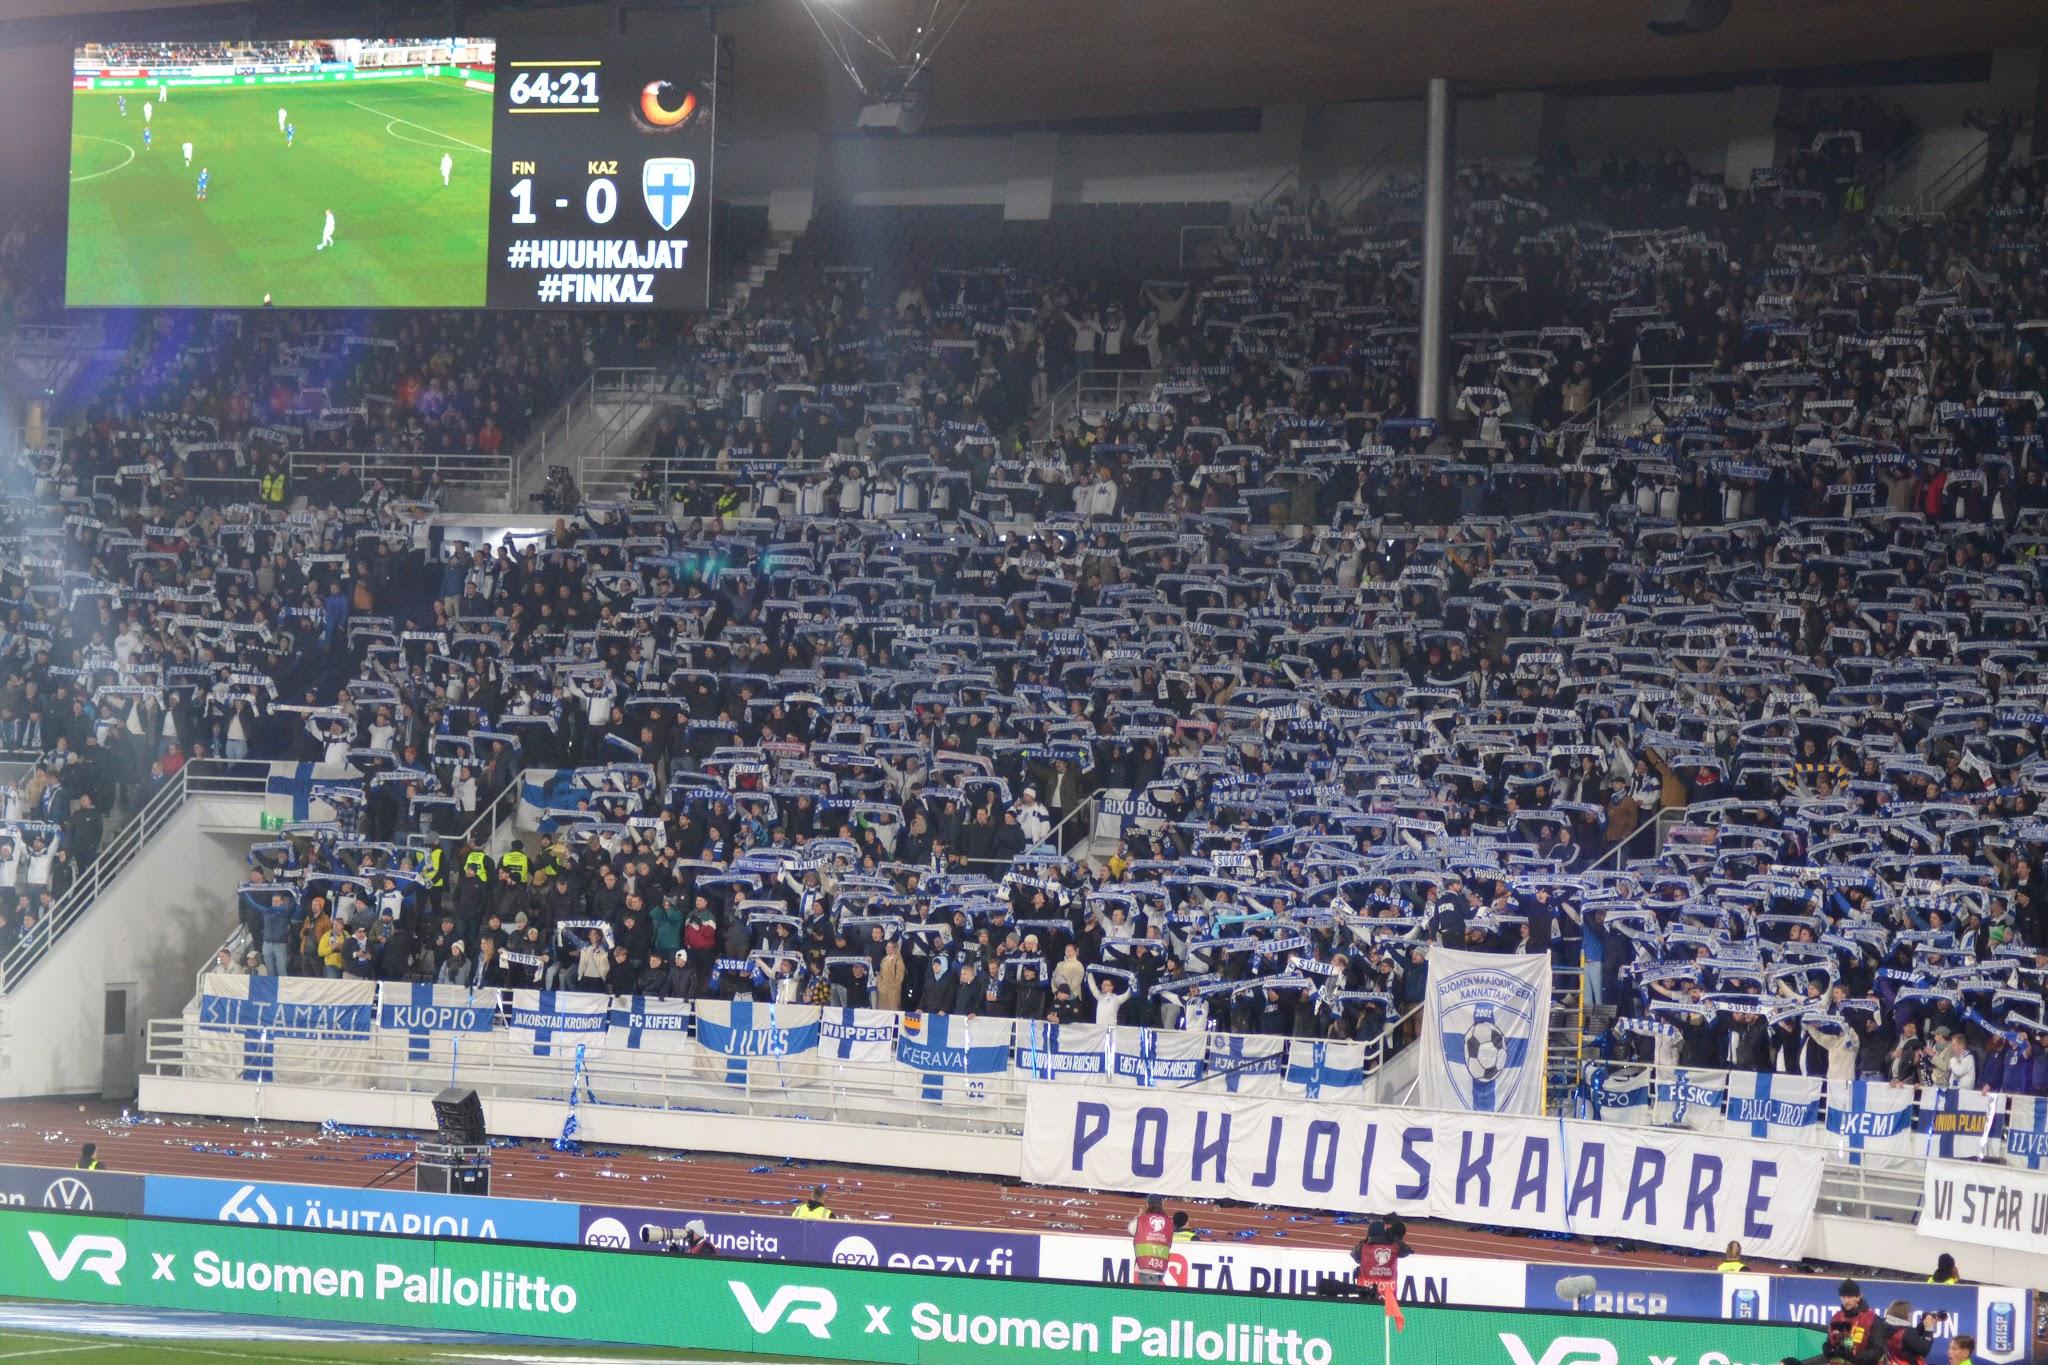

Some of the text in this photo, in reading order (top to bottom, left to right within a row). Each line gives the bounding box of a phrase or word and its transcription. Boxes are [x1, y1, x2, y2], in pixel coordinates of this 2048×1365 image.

[509, 71, 599, 104] 64:21
[512, 161, 618, 175] FIN KAZ
[511, 180, 536, 223] 1
[586, 179, 618, 223] 0
[508, 239, 687, 270] #HUUHKAJAT
[538, 273, 653, 303] #FINKAZ
[1972, 407, 1999, 418] SUOMI
[1875, 453, 1904, 465] SUOMI
[1048, 632, 1081, 640] SUOMI
[1054, 647, 1083, 655] SUOMI
[2003, 712, 2044, 722] SUOMI
[1293, 721, 1328, 730] SUOMI
[1215, 774, 1249, 789] SUOMI
[686, 790, 731, 798] SUOMI
[1105, 800, 1167, 818] RIXU BOY
[1217, 856, 1245, 865] SUOMI
[1833, 878, 1867, 887] SUOMI
[1173, 913, 1200, 922] SUOMI
[1259, 937, 1307, 952] SUOMI
[718, 960, 747, 971] SUOMI
[1300, 959, 1334, 974] SUOMI
[1887, 969, 1925, 982] SUOMI
[394, 1006, 476, 1029] KUOPIO
[514, 1012, 562, 1029] JAKOBSTAD
[629, 1013, 681, 1030] FC KIFFEN
[903, 1046, 962, 1067] KERAVA
[1845, 1112, 1893, 1136] KEMI
[1073, 1101, 1778, 1240] POHJOISKAARRE
[1935, 1179, 1953, 1220] VI
[1962, 1182, 2023, 1231] STÅR
[1151, 1245, 1163, 1256] TV
[28, 1230, 577, 1316] VR x Suomen Palloliitto
[728, 1280, 1333, 1365] VR x Suomen Palloliitto
